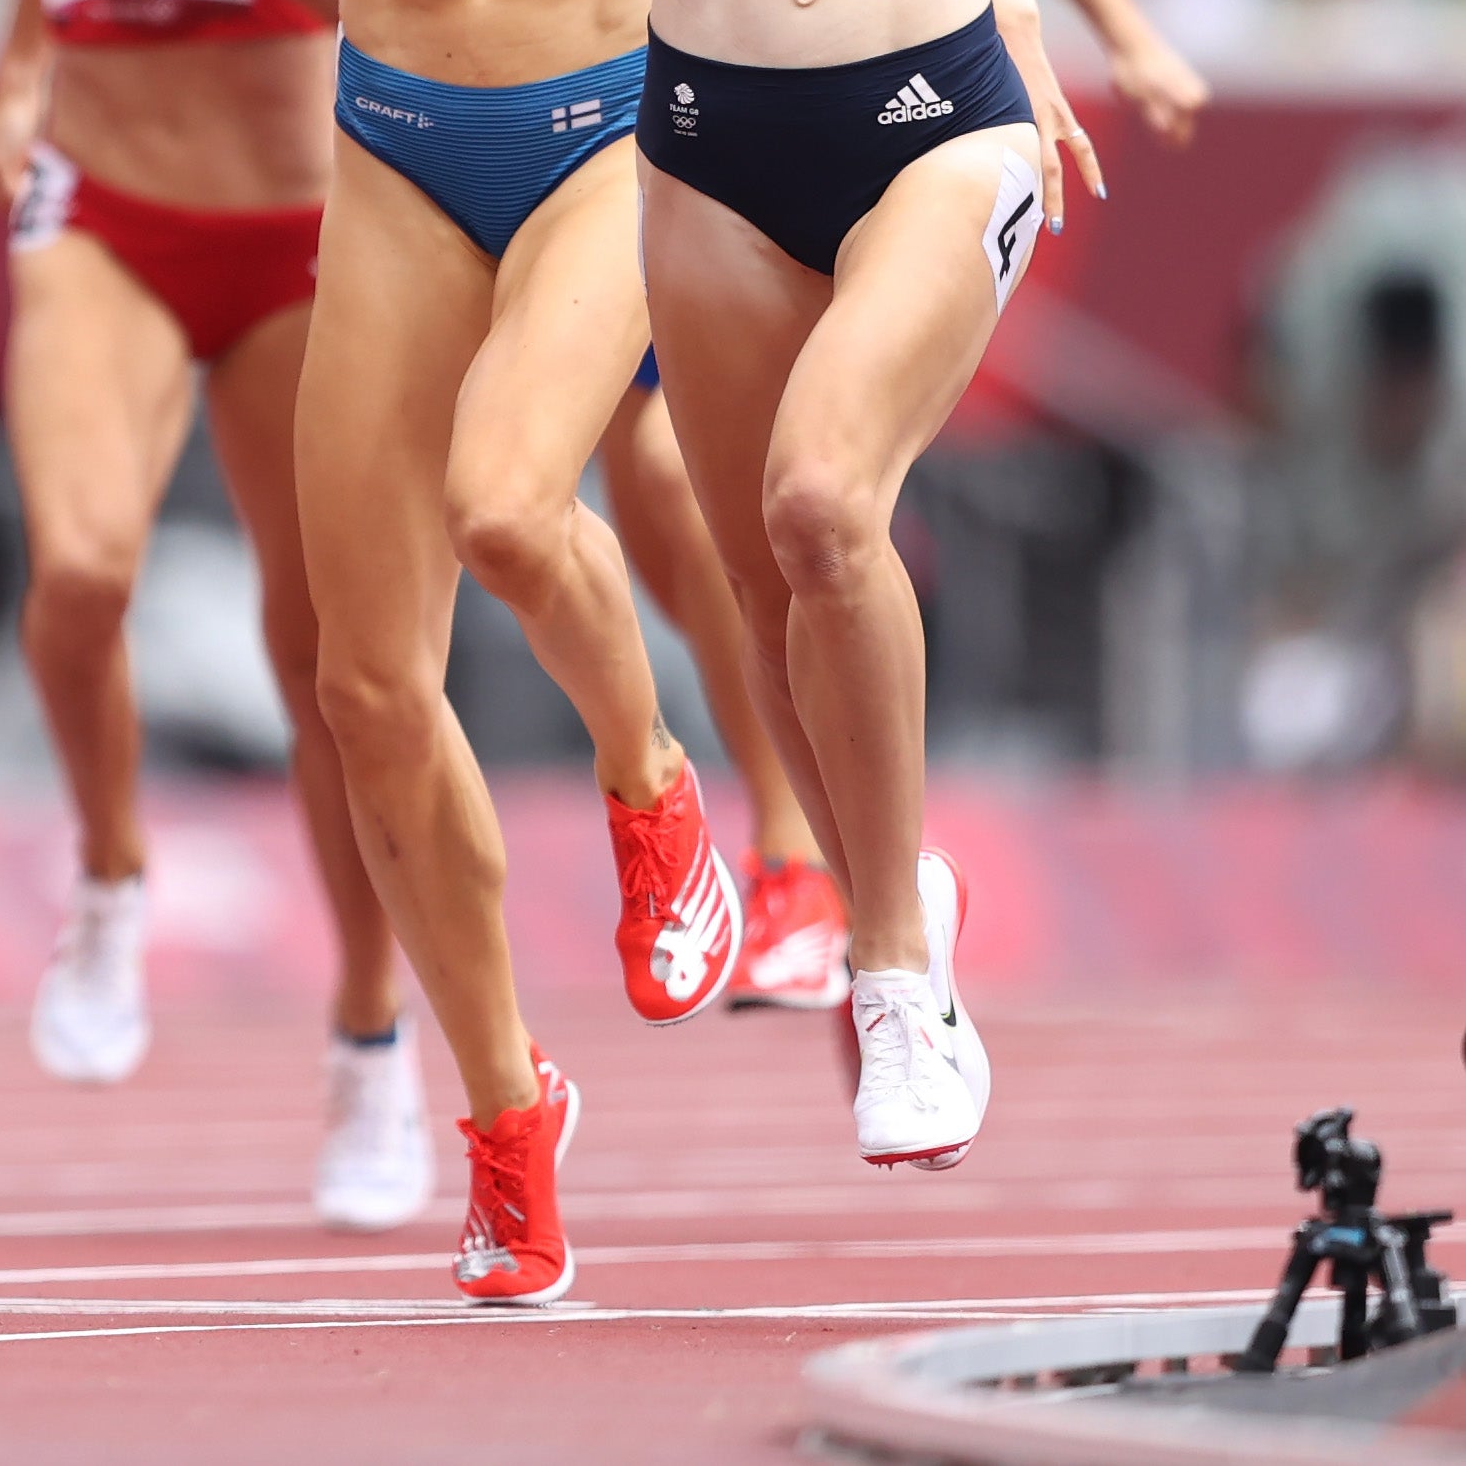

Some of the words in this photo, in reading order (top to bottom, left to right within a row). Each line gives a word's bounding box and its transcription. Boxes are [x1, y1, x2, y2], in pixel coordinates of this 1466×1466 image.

[355, 96, 417, 124] CRAFT
[877, 99, 955, 125] adidas
[997, 191, 1034, 282] 4
